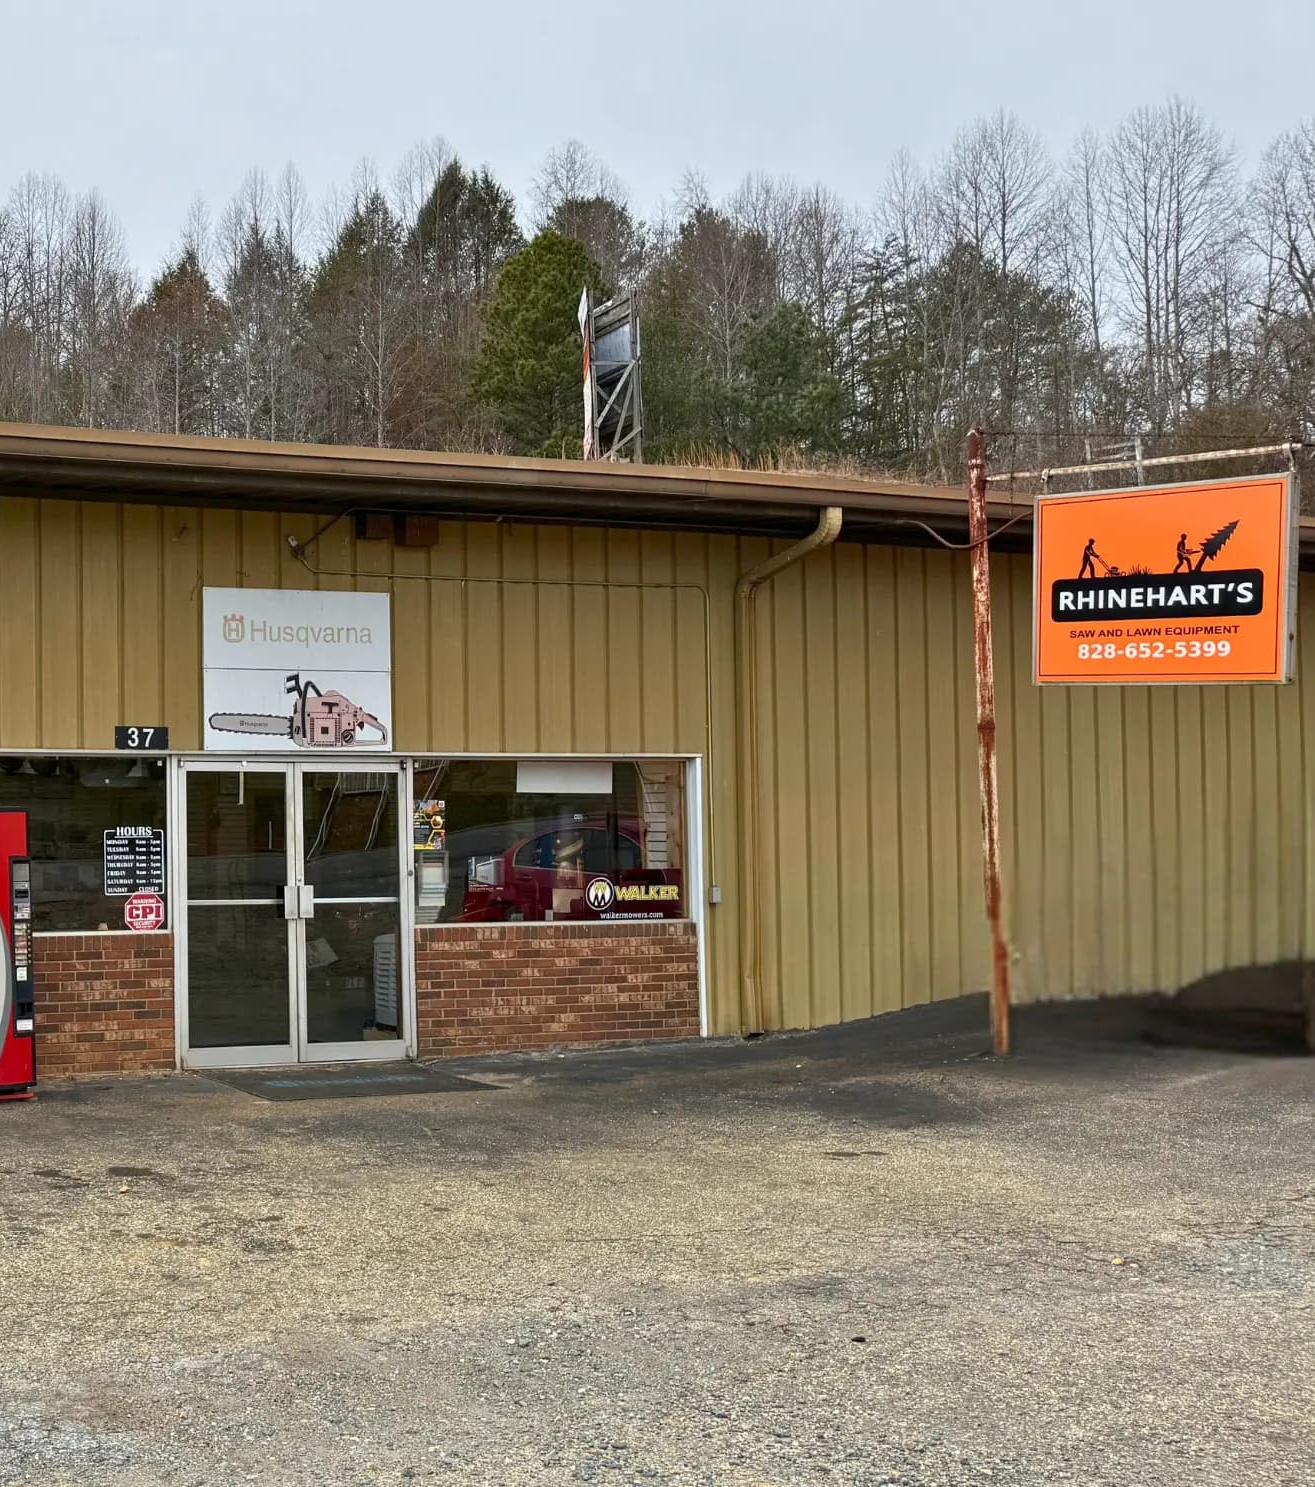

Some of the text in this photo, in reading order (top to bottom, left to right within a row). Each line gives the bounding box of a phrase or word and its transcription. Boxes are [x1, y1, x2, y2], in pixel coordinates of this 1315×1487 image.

[1058, 581, 1254, 611] RHINEHART'S
[250, 620, 372, 648] Husqvarna
[1069, 625, 1240, 639] SAW AND LAWN EQUIPMENT
[1077, 640, 1231, 660] 828-652-5399
[127, 727, 155, 747] 37
[116, 826, 152, 836] HOURS
[614, 885, 679, 901] WALKER
[128, 905, 161, 919] CPI
[600, 911, 664, 919] walkermowers.com
